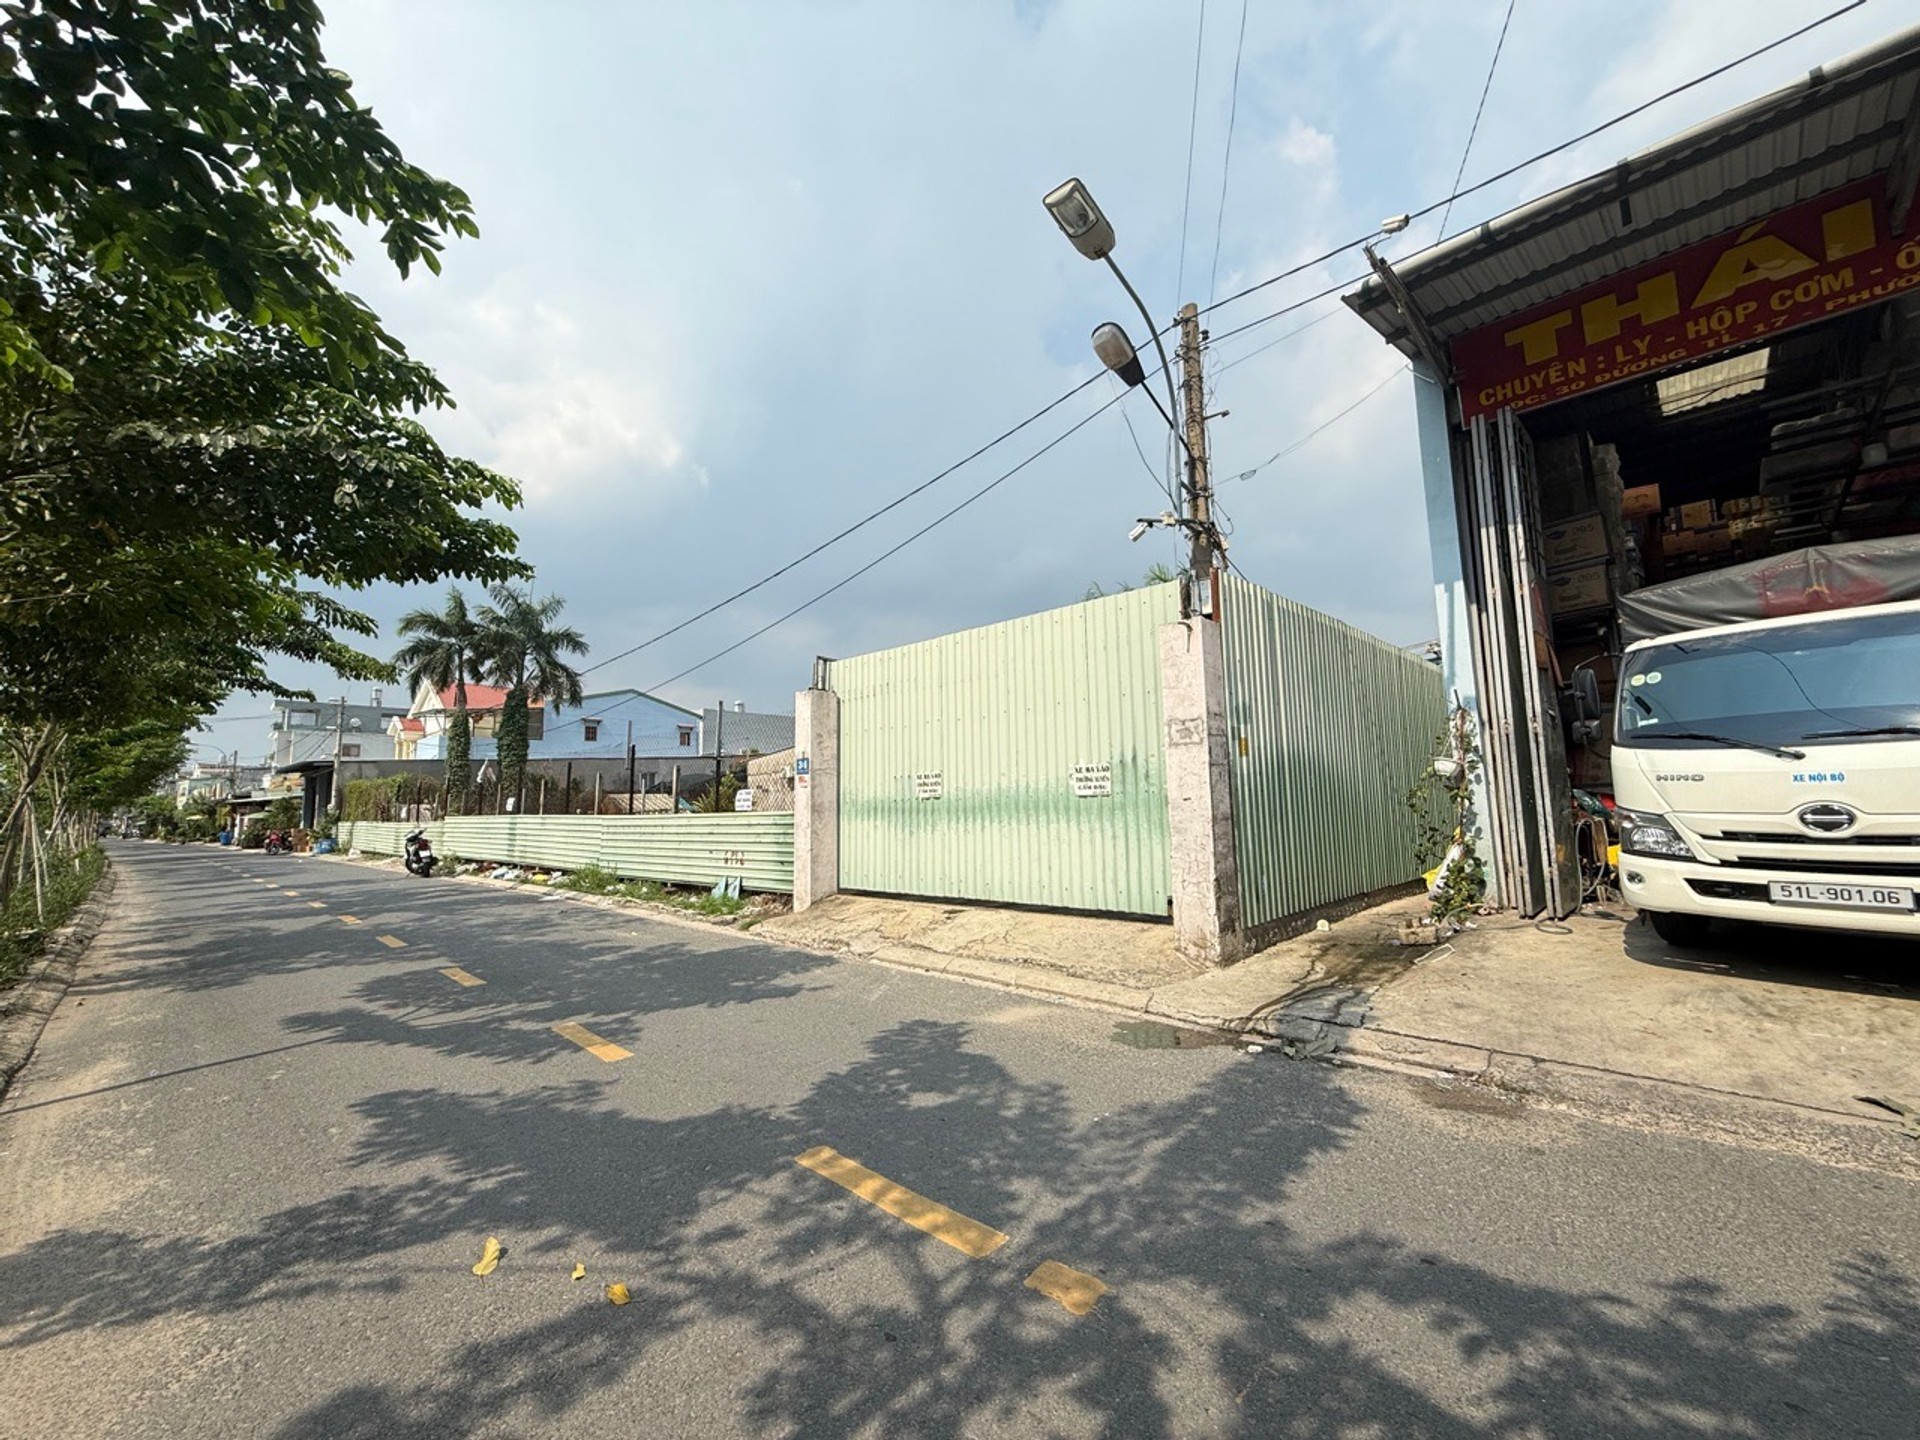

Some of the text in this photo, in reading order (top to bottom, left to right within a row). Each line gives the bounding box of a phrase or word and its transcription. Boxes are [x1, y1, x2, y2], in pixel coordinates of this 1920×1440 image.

[1504, 198, 1877, 366] THÁI
[1479, 357, 1587, 406] CHUYÊN
[1615, 334, 1652, 363] LY
[1686, 299, 1758, 339] HỘP
[1769, 268, 1855, 311] CƠM
[1555, 380, 1587, 396] 30
[1593, 348, 1688, 384] ĐƯỜNG
[1753, 314, 1789, 335] 17
[1656, 773, 1705, 782] HINO
[1792, 771, 1845, 784] XE NỘI BỘ
[1780, 885, 1900, 904] 51L-901.06
